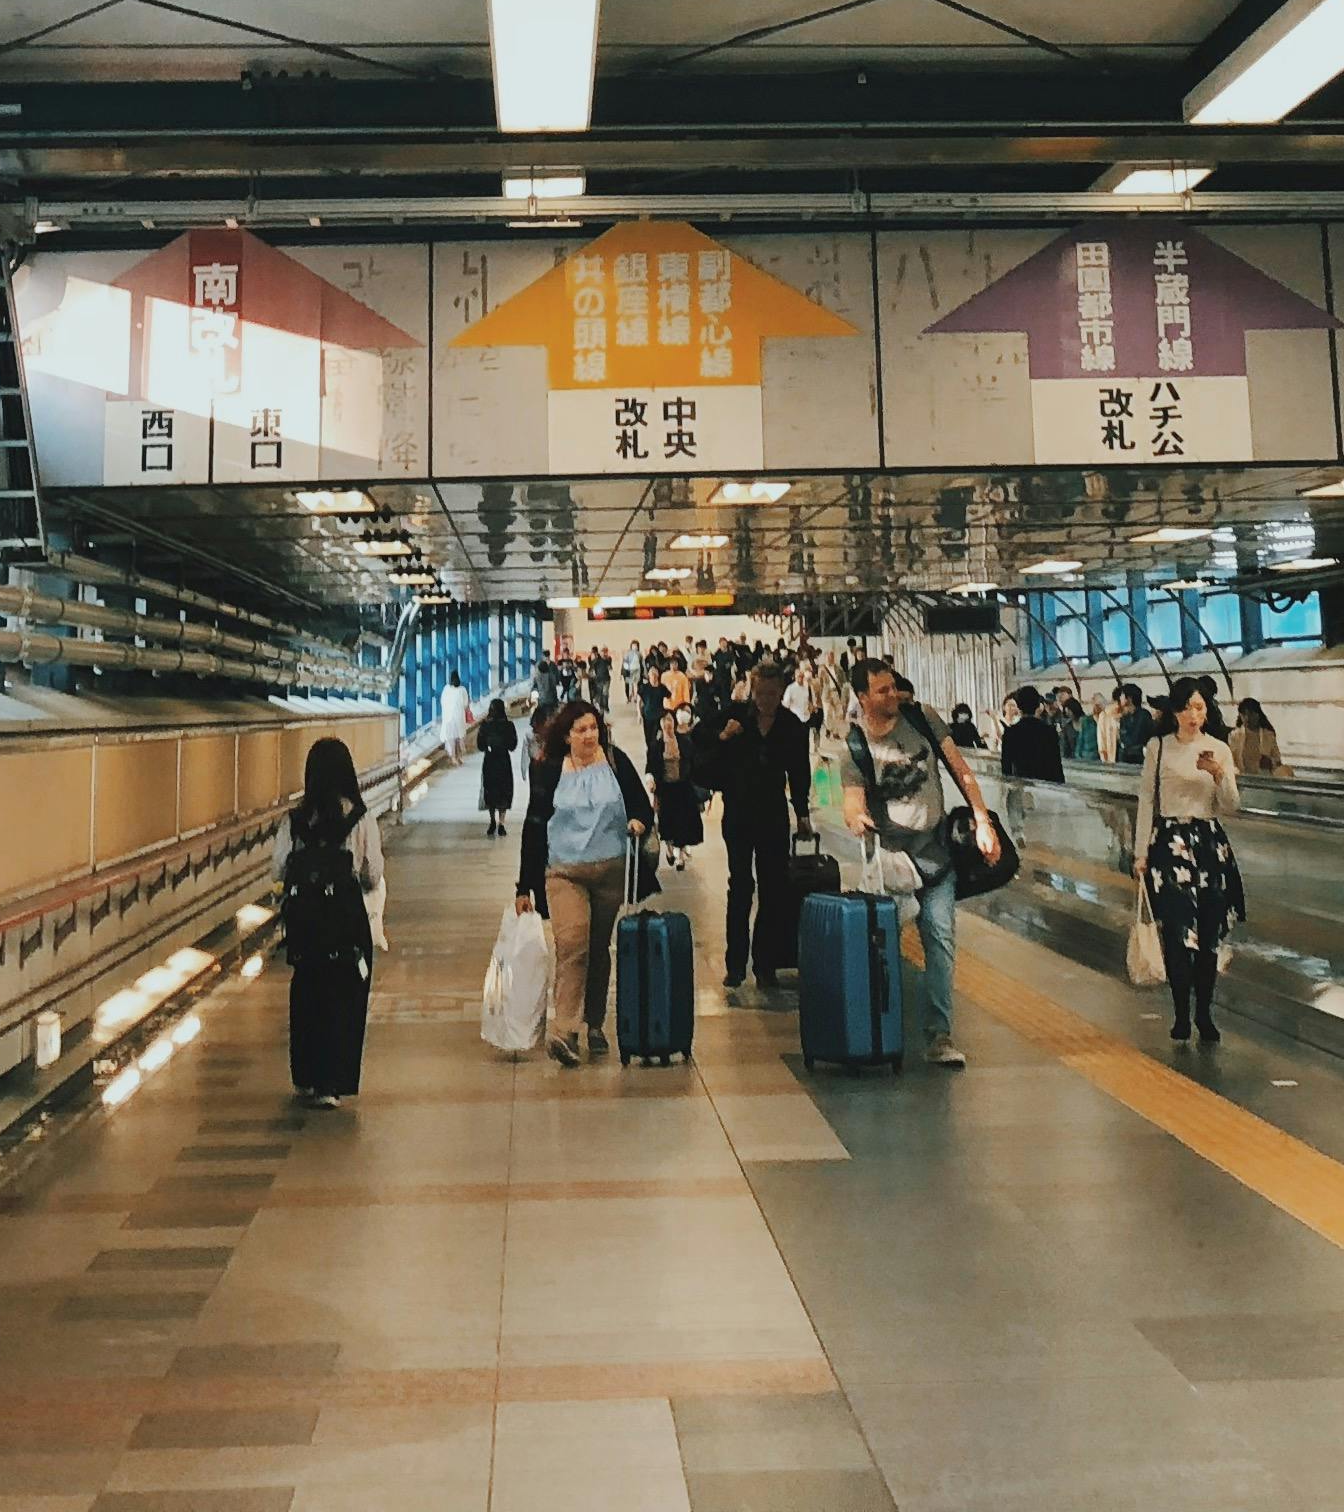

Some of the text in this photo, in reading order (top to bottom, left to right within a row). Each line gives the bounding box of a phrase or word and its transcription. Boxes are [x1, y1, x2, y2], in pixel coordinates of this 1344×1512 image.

[614, 252, 649, 346] 銀座線
[658, 251, 690, 345] 東横線
[698, 249, 733, 378] 副都心線
[1076, 242, 1116, 371] 田園都市線
[1153, 241, 1194, 371] 半蔵門線
[141, 409, 174, 472] 西口
[250, 408, 282, 469] 東口
[615, 397, 649, 459] 改札
[662, 396, 697, 459] 中央
[1099, 388, 1135, 450] 改札
[1149, 382, 1185, 456] ハチ公
